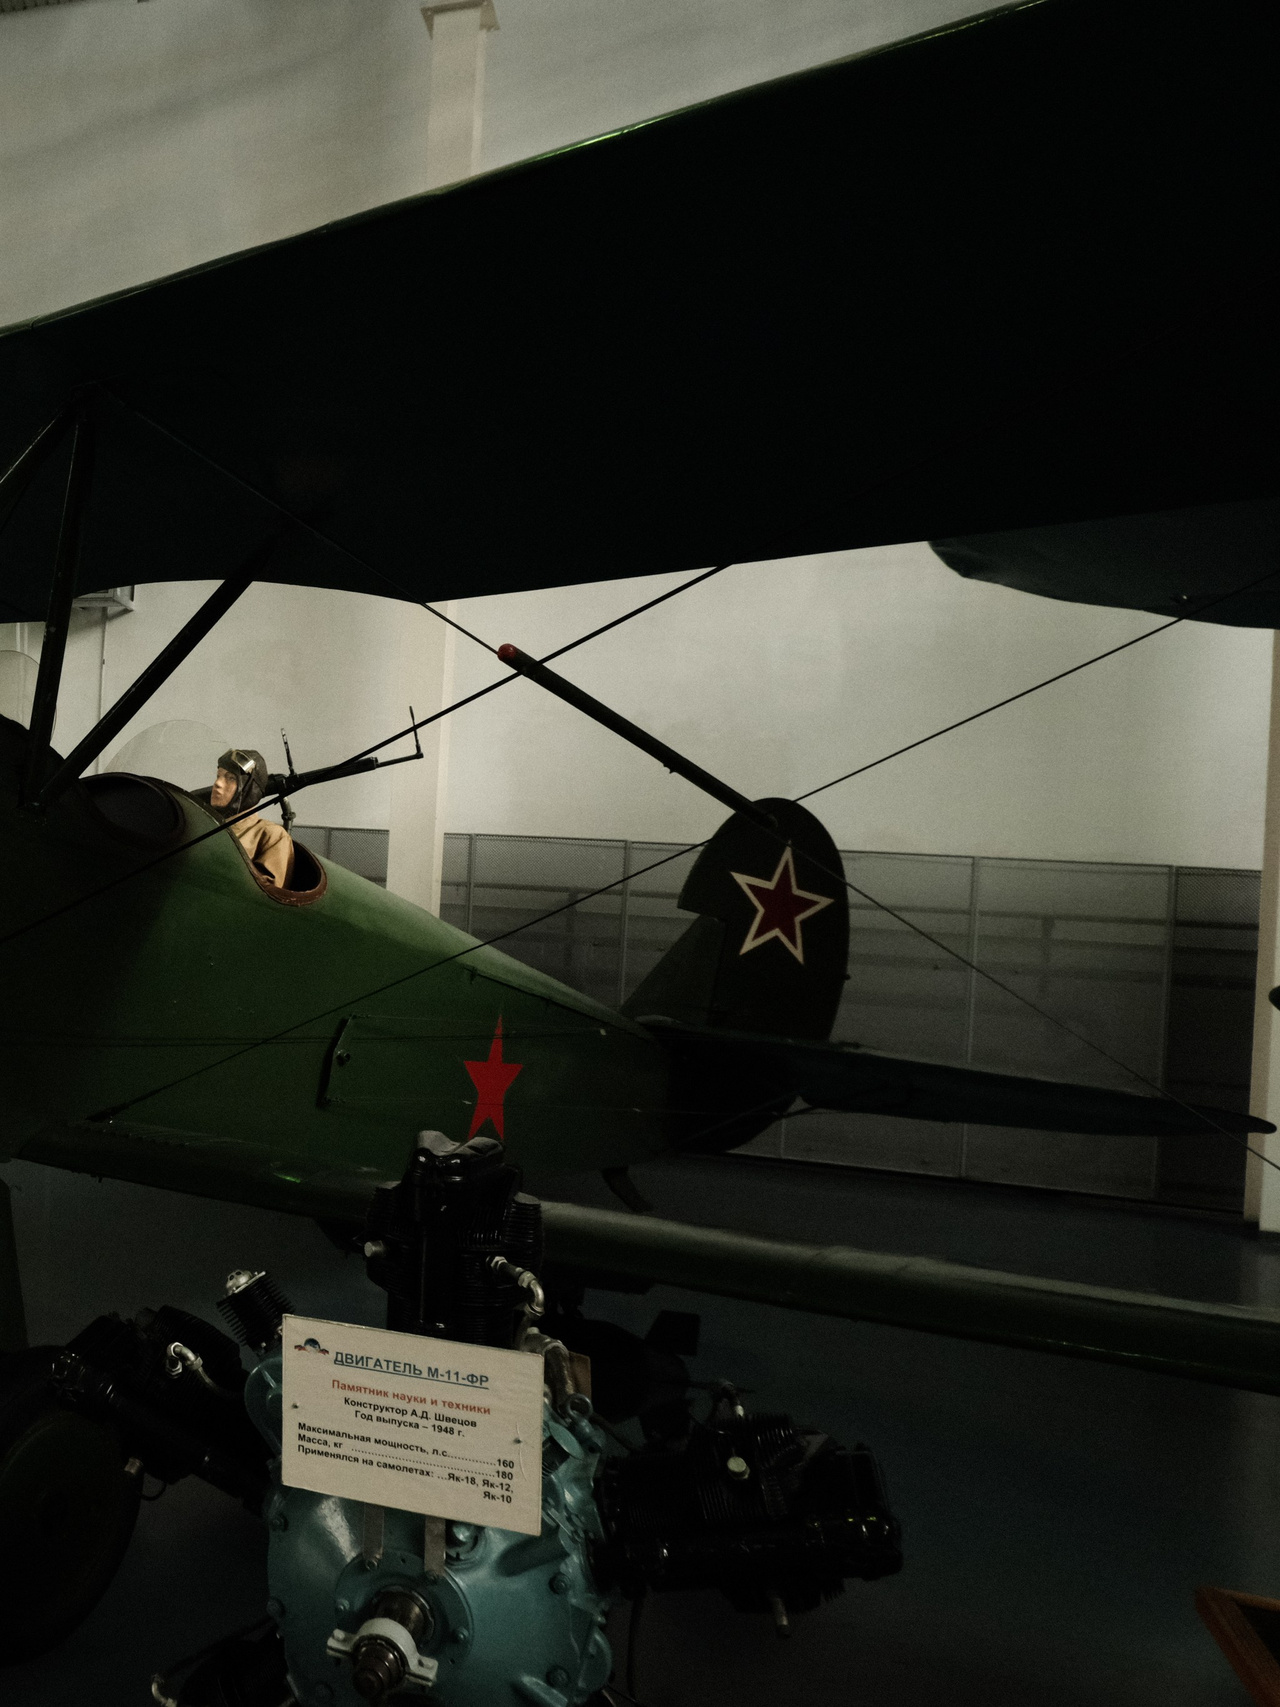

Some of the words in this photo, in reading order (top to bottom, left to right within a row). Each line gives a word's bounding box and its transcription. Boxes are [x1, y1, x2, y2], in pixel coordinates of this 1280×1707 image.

[333, 1351, 423, 1376] ДВИГАТЕЛЬ
[427, 1366, 490, 1386] М-11-ФР
[332, 1379, 390, 1398] Памятник
[392, 1392, 427, 1406] науки
[431, 1398, 438, 1406] и
[441, 1400, 491, 1415] техники
[344, 1397, 408, 1417] Конструктор
[410, 1408, 431, 1421] А.Д.
[434, 1412, 477, 1428] Швецов
[355, 1410, 374, 1422] Год
[376, 1416, 420, 1430] выпуска
[431, 1424, 455, 1436] 1948
[457, 1429, 465, 1438] г.
[298, 1422, 371, 1443] Максимальная
[374, 1437, 429, 1455] мощность,
[496, 1458, 515, 1469] 160
[298, 1433, 331, 1448] Масса,
[333, 1441, 343, 1449] кг
[495, 1470, 514, 1481] 180
[298, 1444, 359, 1463] Применялся
[362, 1458, 374, 1466] на
[376, 1460, 434, 1478] самолетах:
[482, 1479, 514, 1494] Як-12,
[483, 1490, 512, 1504] Як-10
